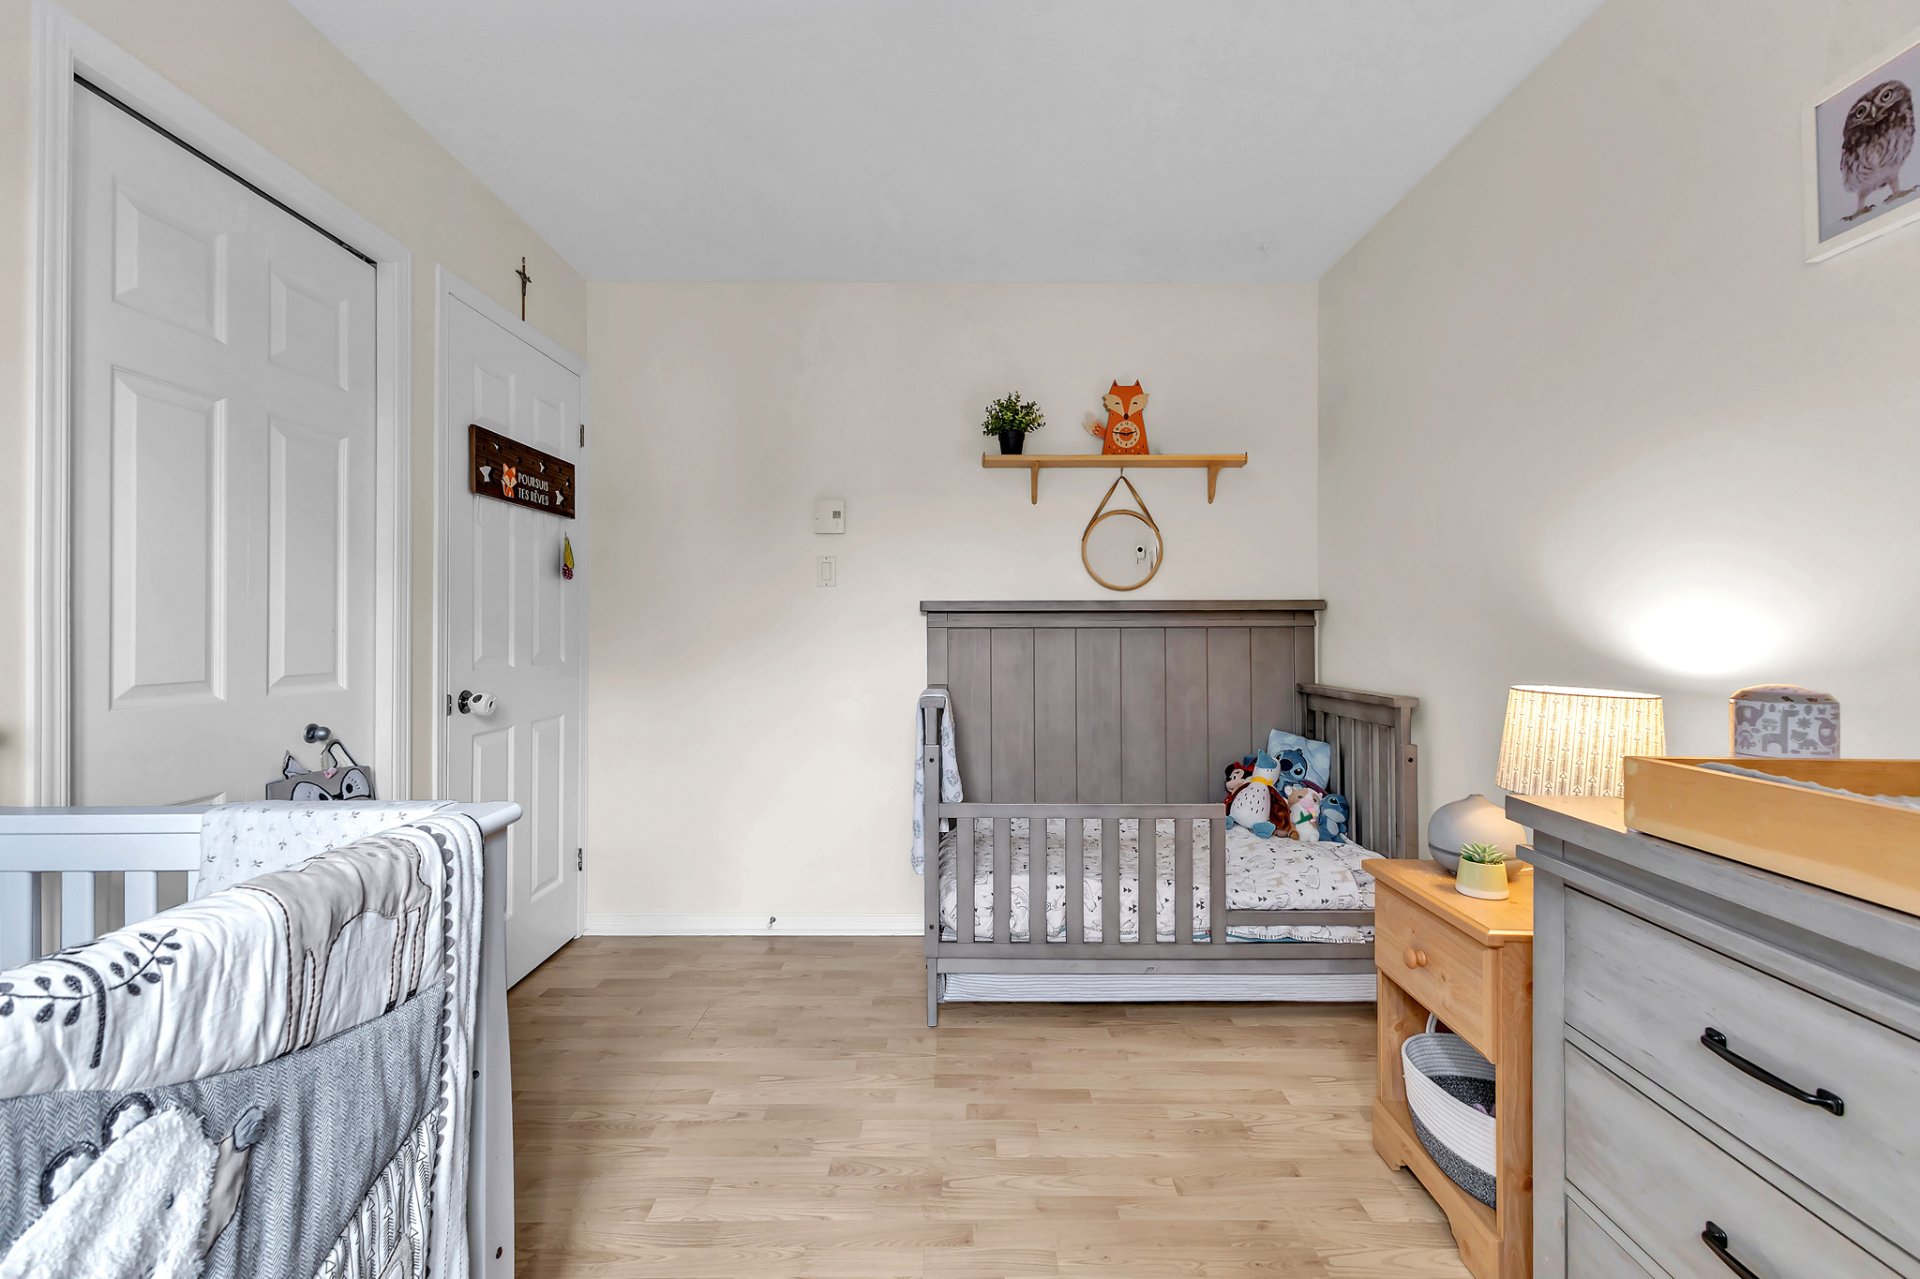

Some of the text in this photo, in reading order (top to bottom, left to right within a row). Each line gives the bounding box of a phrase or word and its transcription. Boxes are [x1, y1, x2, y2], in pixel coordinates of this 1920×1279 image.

[518, 472, 549, 491] POURSUIS
[518, 487, 549, 506] TES RÊVES
